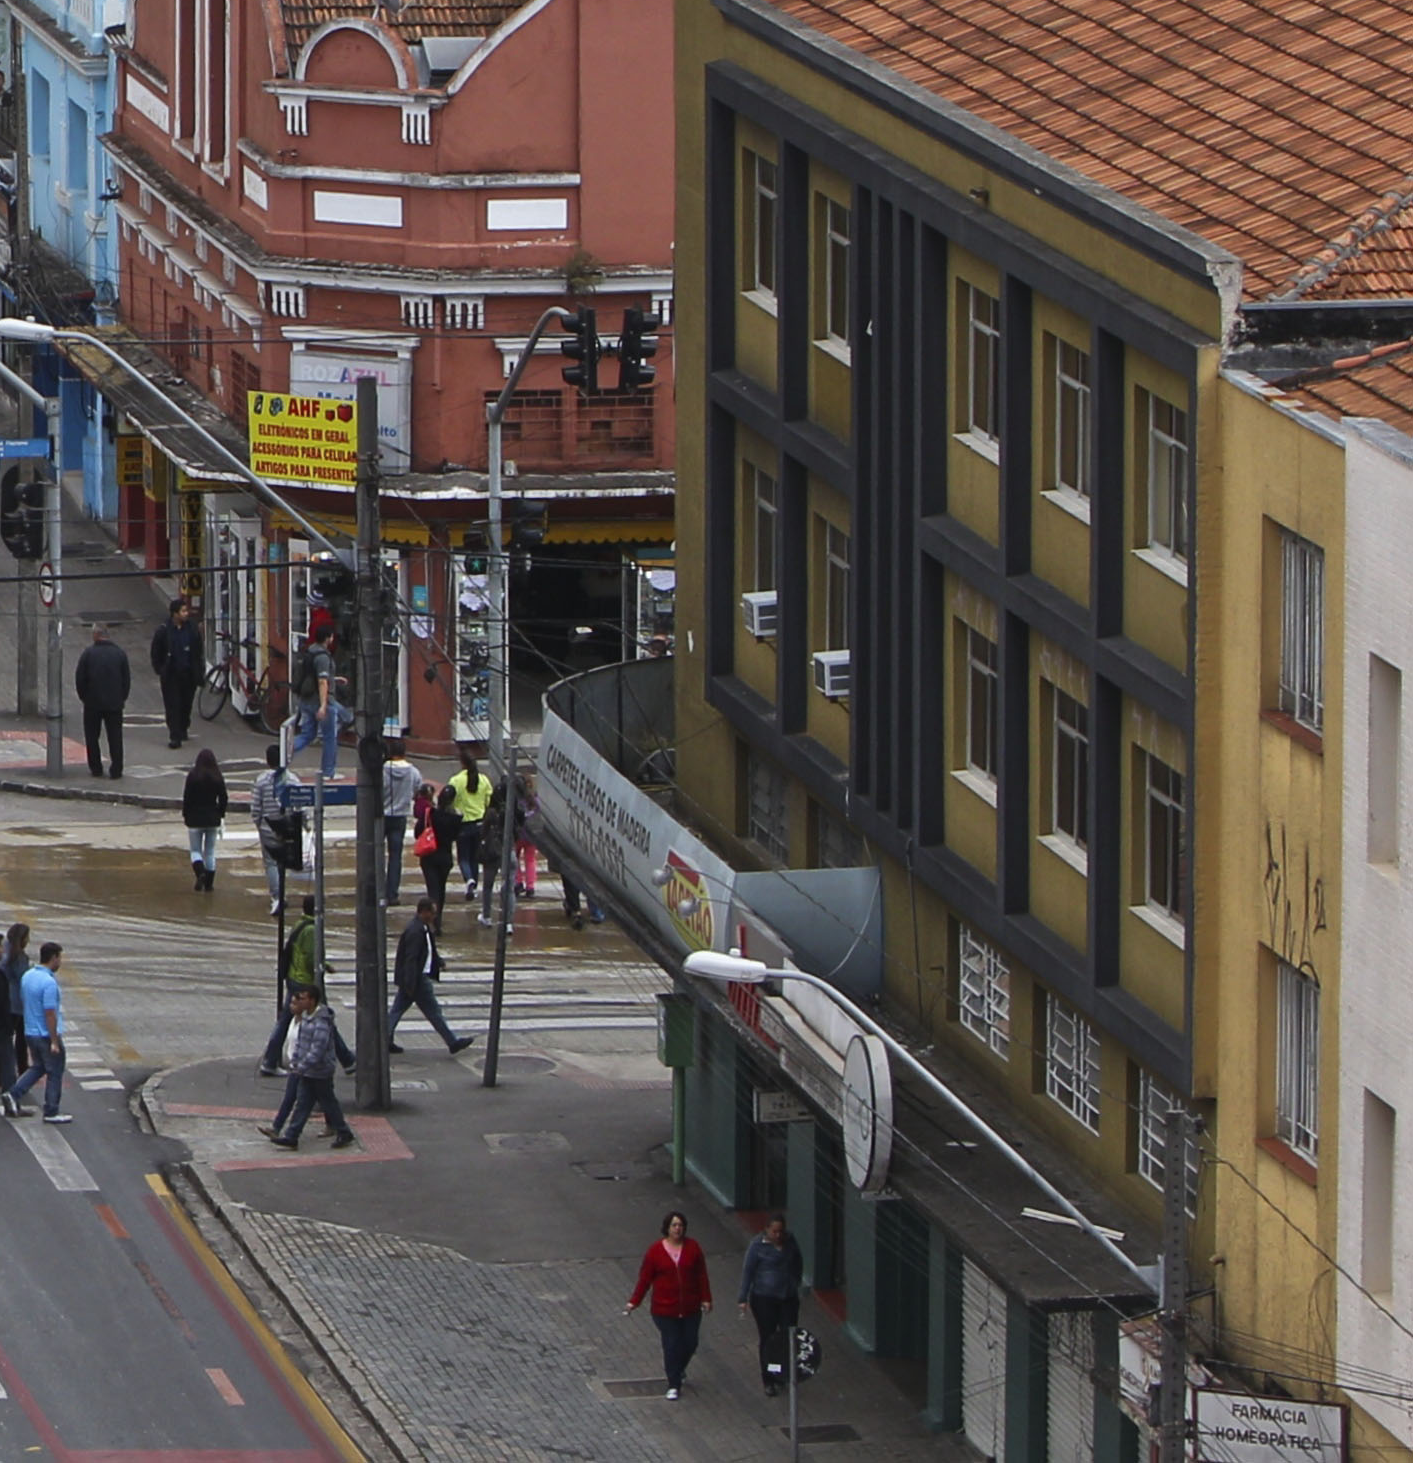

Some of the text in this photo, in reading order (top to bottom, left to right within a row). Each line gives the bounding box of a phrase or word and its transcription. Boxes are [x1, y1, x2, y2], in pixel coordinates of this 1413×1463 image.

[287, 398, 321, 419] AHF
[311, 428, 324, 443] EM
[324, 429, 350, 444] GERAL
[301, 446, 322, 460] PARA
[255, 461, 356, 482] ARTIGOS PARA PRESENTES
[546, 743, 580, 794] CARPETES
[585, 776, 606, 820] PISOS
[616, 805, 651, 858] MADEIRA
